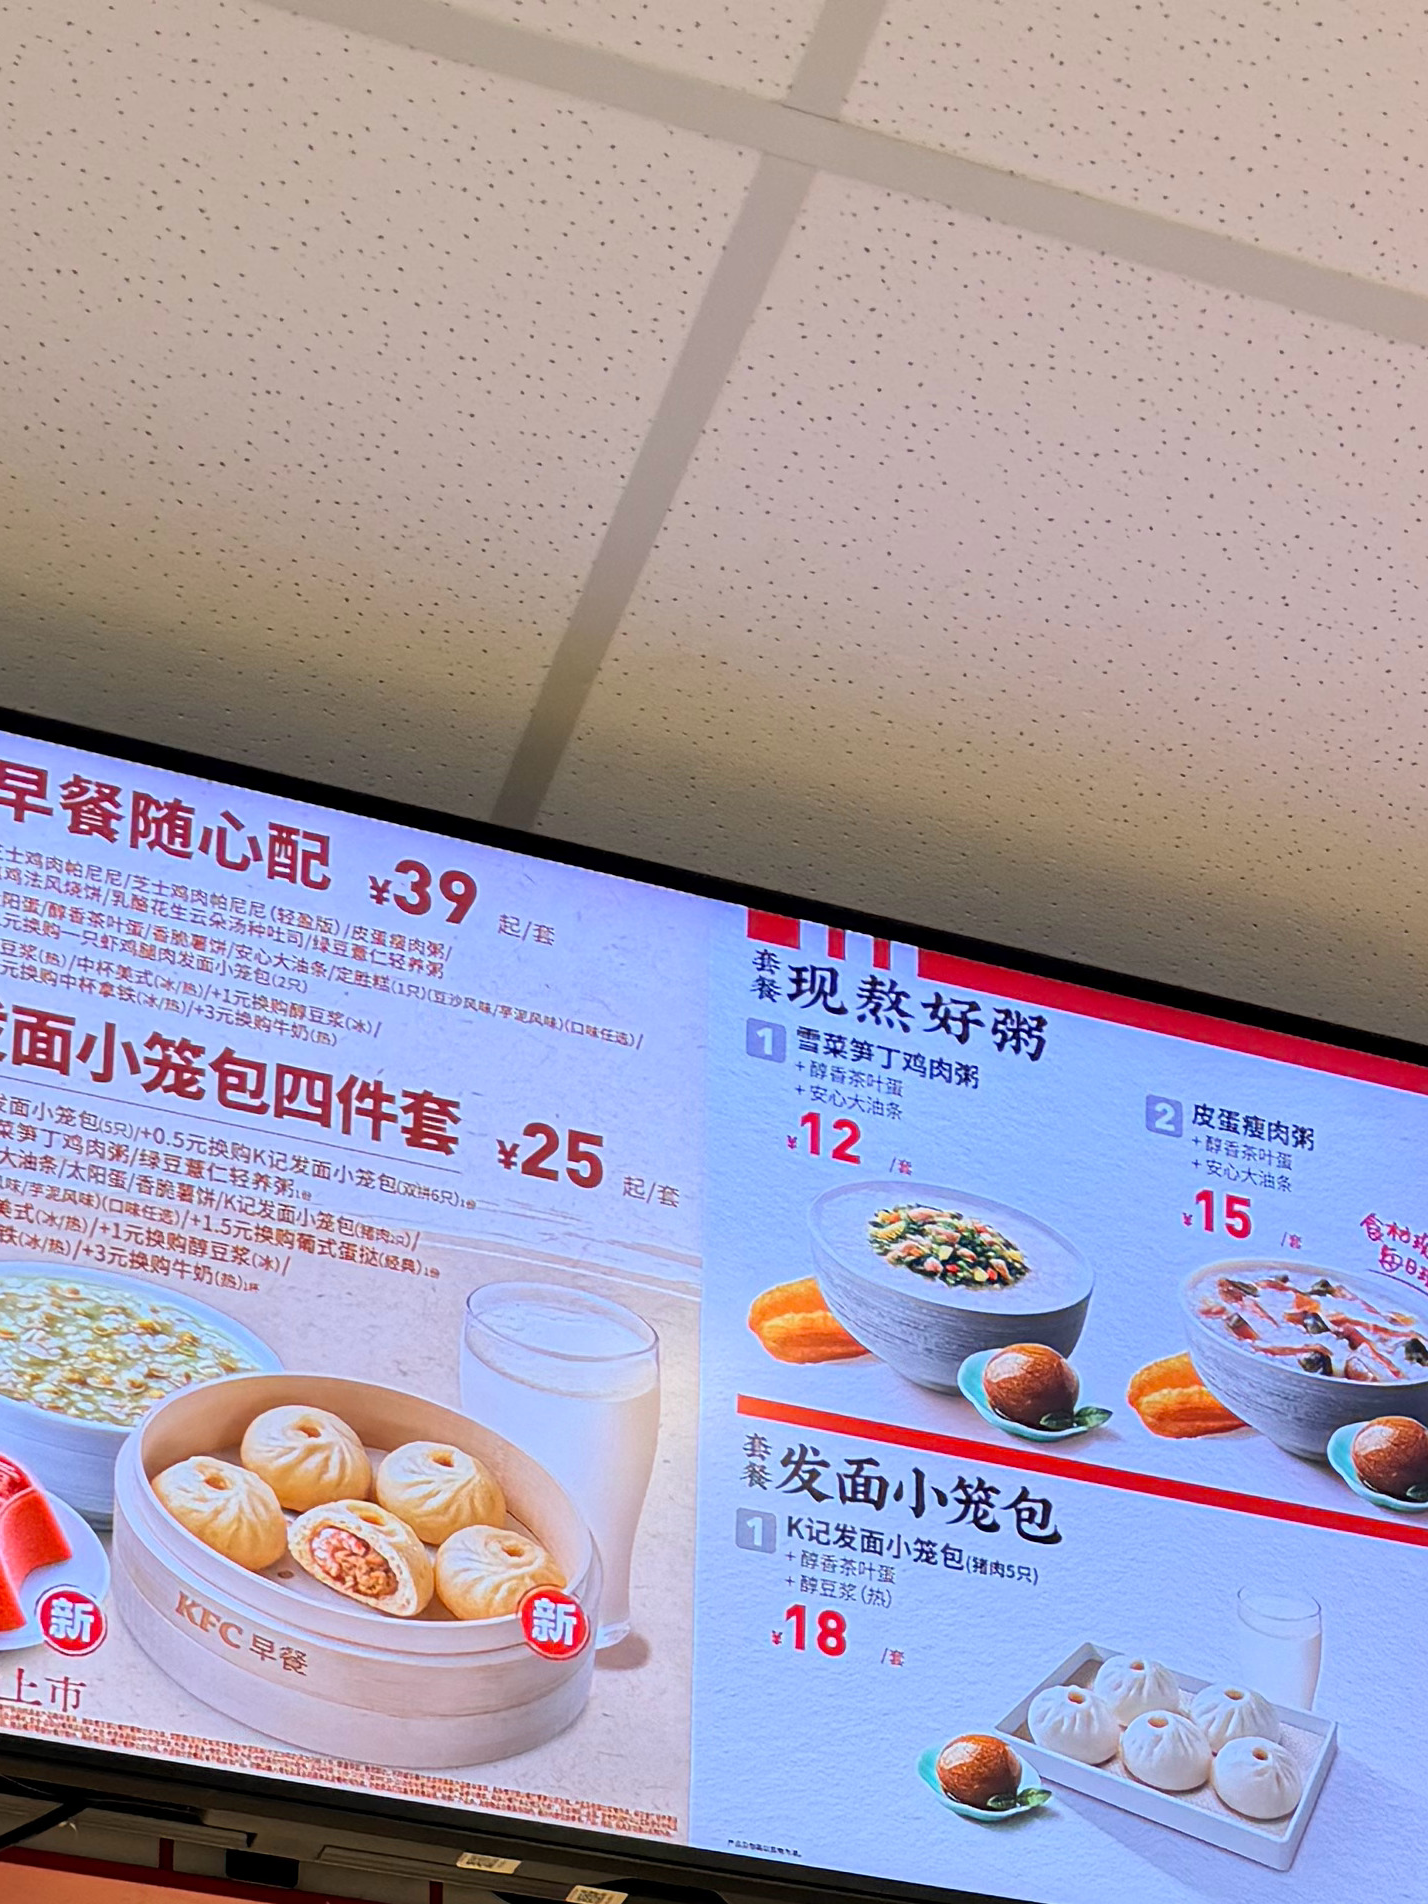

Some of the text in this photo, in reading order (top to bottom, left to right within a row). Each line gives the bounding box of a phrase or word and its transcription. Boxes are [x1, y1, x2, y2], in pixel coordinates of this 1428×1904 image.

[368, 859, 478, 925] ¥39
[497, 913, 556, 946] 起/套
[751, 948, 781, 1002] 套餐
[787, 964, 1048, 1062] 现熬好粥
[756, 1026, 773, 1055] 1
[796, 1026, 980, 1089] 雪菜笋丁鸡肉粥
[786, 1111, 861, 1165] ¥12
[1154, 1103, 1176, 1132] 2
[1192, 1103, 1315, 1151] 皮蛋瘦肉粥
[496, 1121, 605, 1190] ¥25
[623, 1176, 680, 1209] 起/套
[1182, 1189, 1252, 1239] ¥15
[741, 1432, 772, 1490] 套餐
[774, 1443, 1063, 1545] 发面小笼包
[746, 1516, 764, 1547] 1
[787, 1516, 1039, 1585] K记发面小笼包(猪肉5只)
[49, 1597, 94, 1643] 新
[176, 1592, 309, 1677] KFC 早餐
[533, 1600, 578, 1648] 新
[771, 1604, 847, 1657] ¥18
